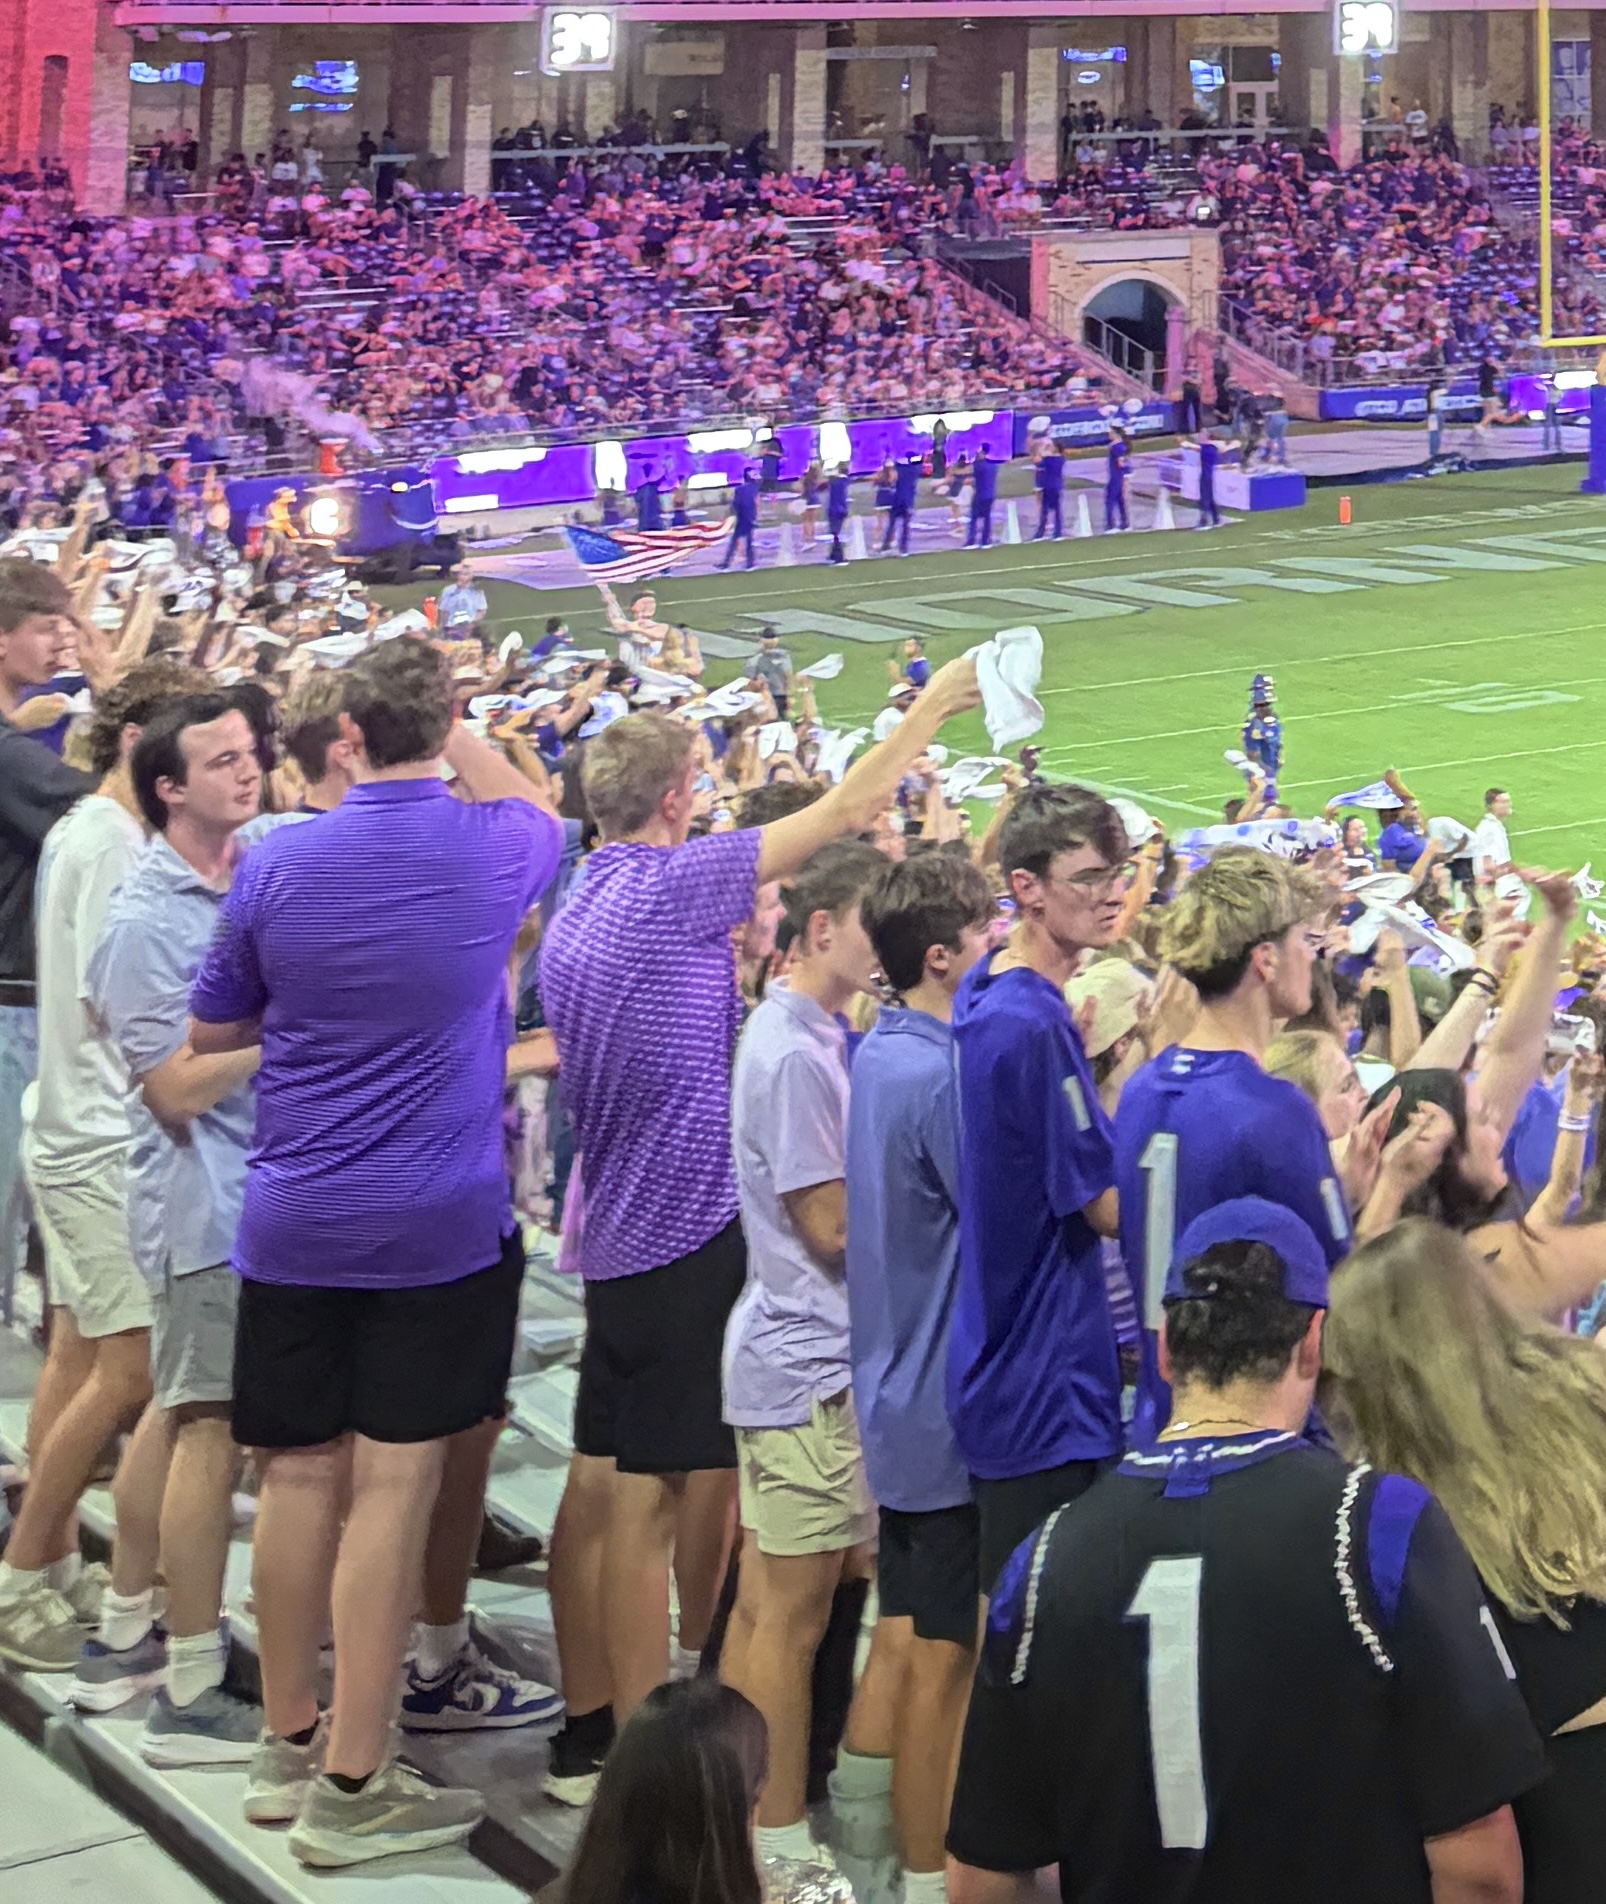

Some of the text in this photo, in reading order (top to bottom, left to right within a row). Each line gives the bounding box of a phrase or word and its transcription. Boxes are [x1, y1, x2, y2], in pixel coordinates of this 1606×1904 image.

[1062, 1075, 1092, 1132] 1
[1138, 1132, 1178, 1330] 1
[1126, 1557, 1208, 1849] 1
[1479, 1605, 1517, 1680] 1
